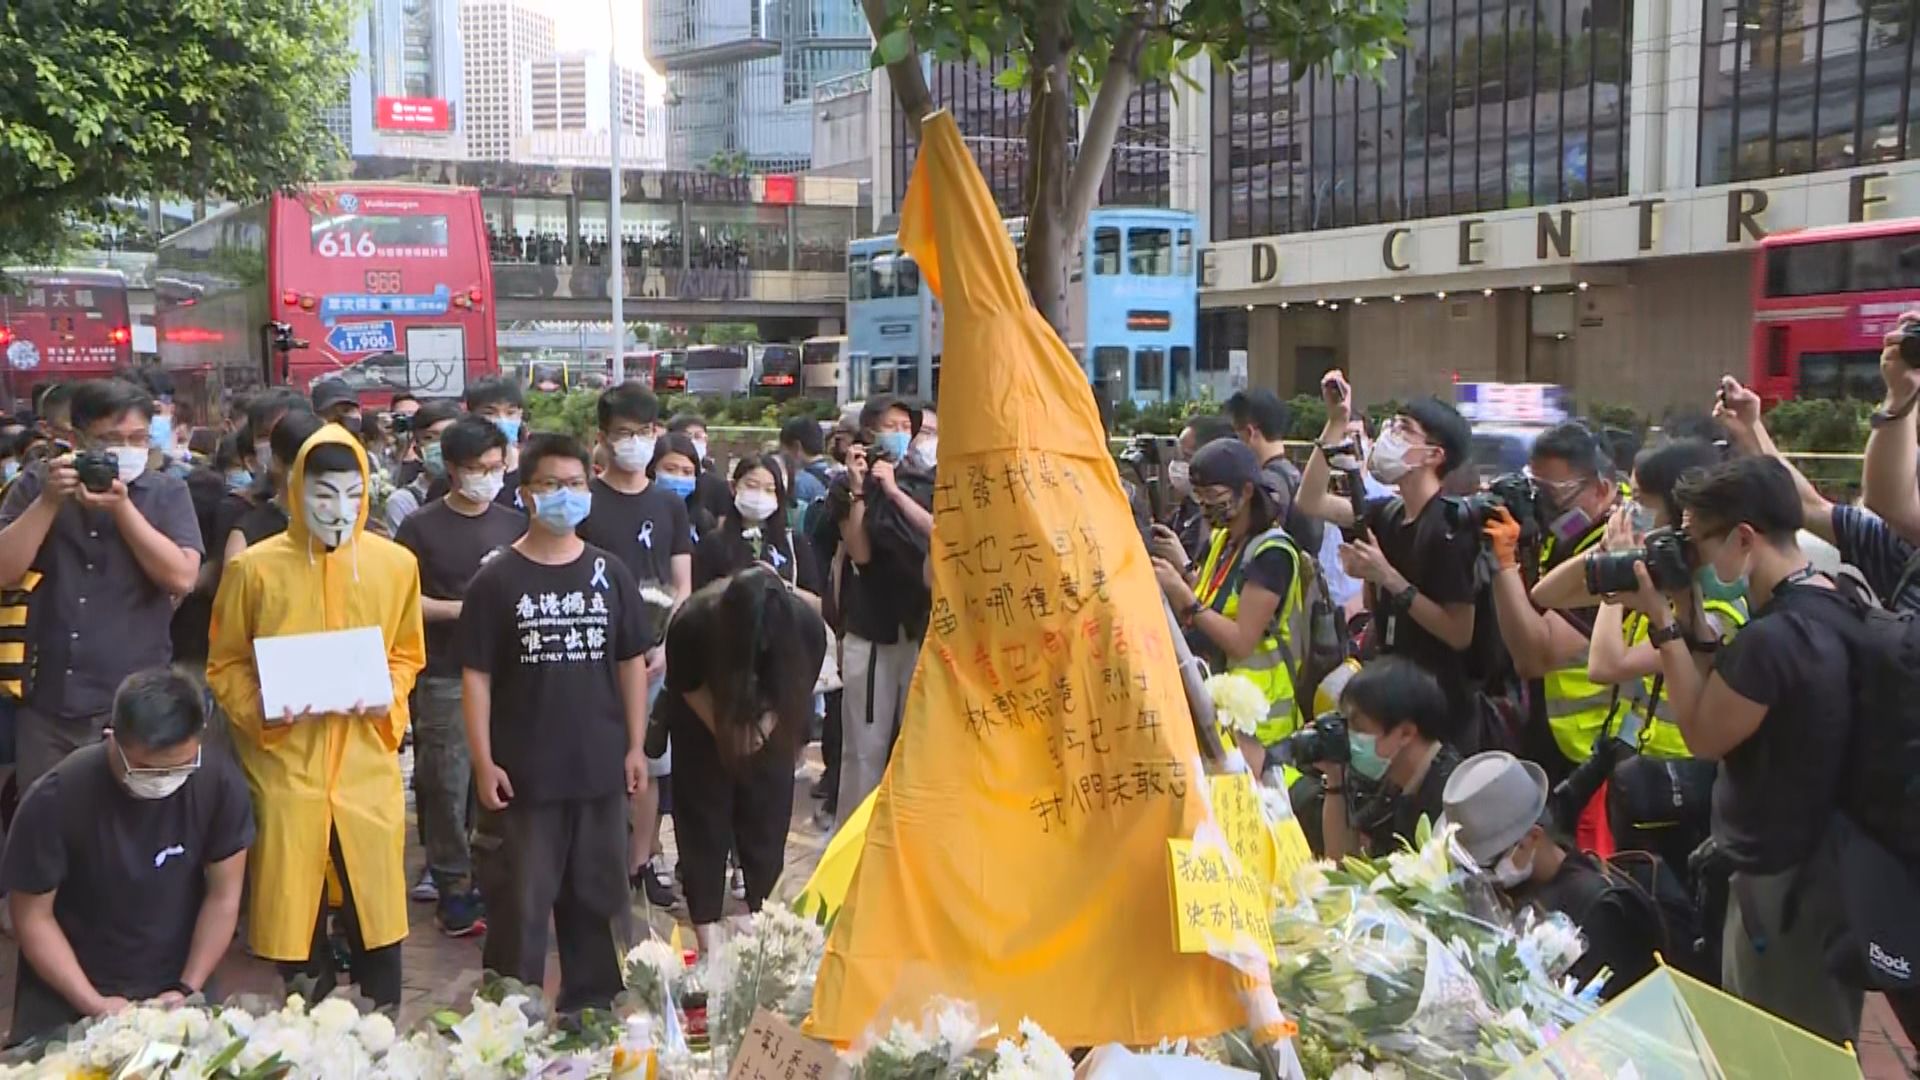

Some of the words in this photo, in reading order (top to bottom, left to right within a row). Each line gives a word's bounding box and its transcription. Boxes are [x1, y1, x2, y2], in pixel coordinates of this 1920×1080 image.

[319, 232, 376, 257] 616
[520, 655, 539, 663] THE
[540, 652, 562, 661] ONLY
[567, 651, 588, 661] WAY
[1869, 941, 1911, 973] iStock
